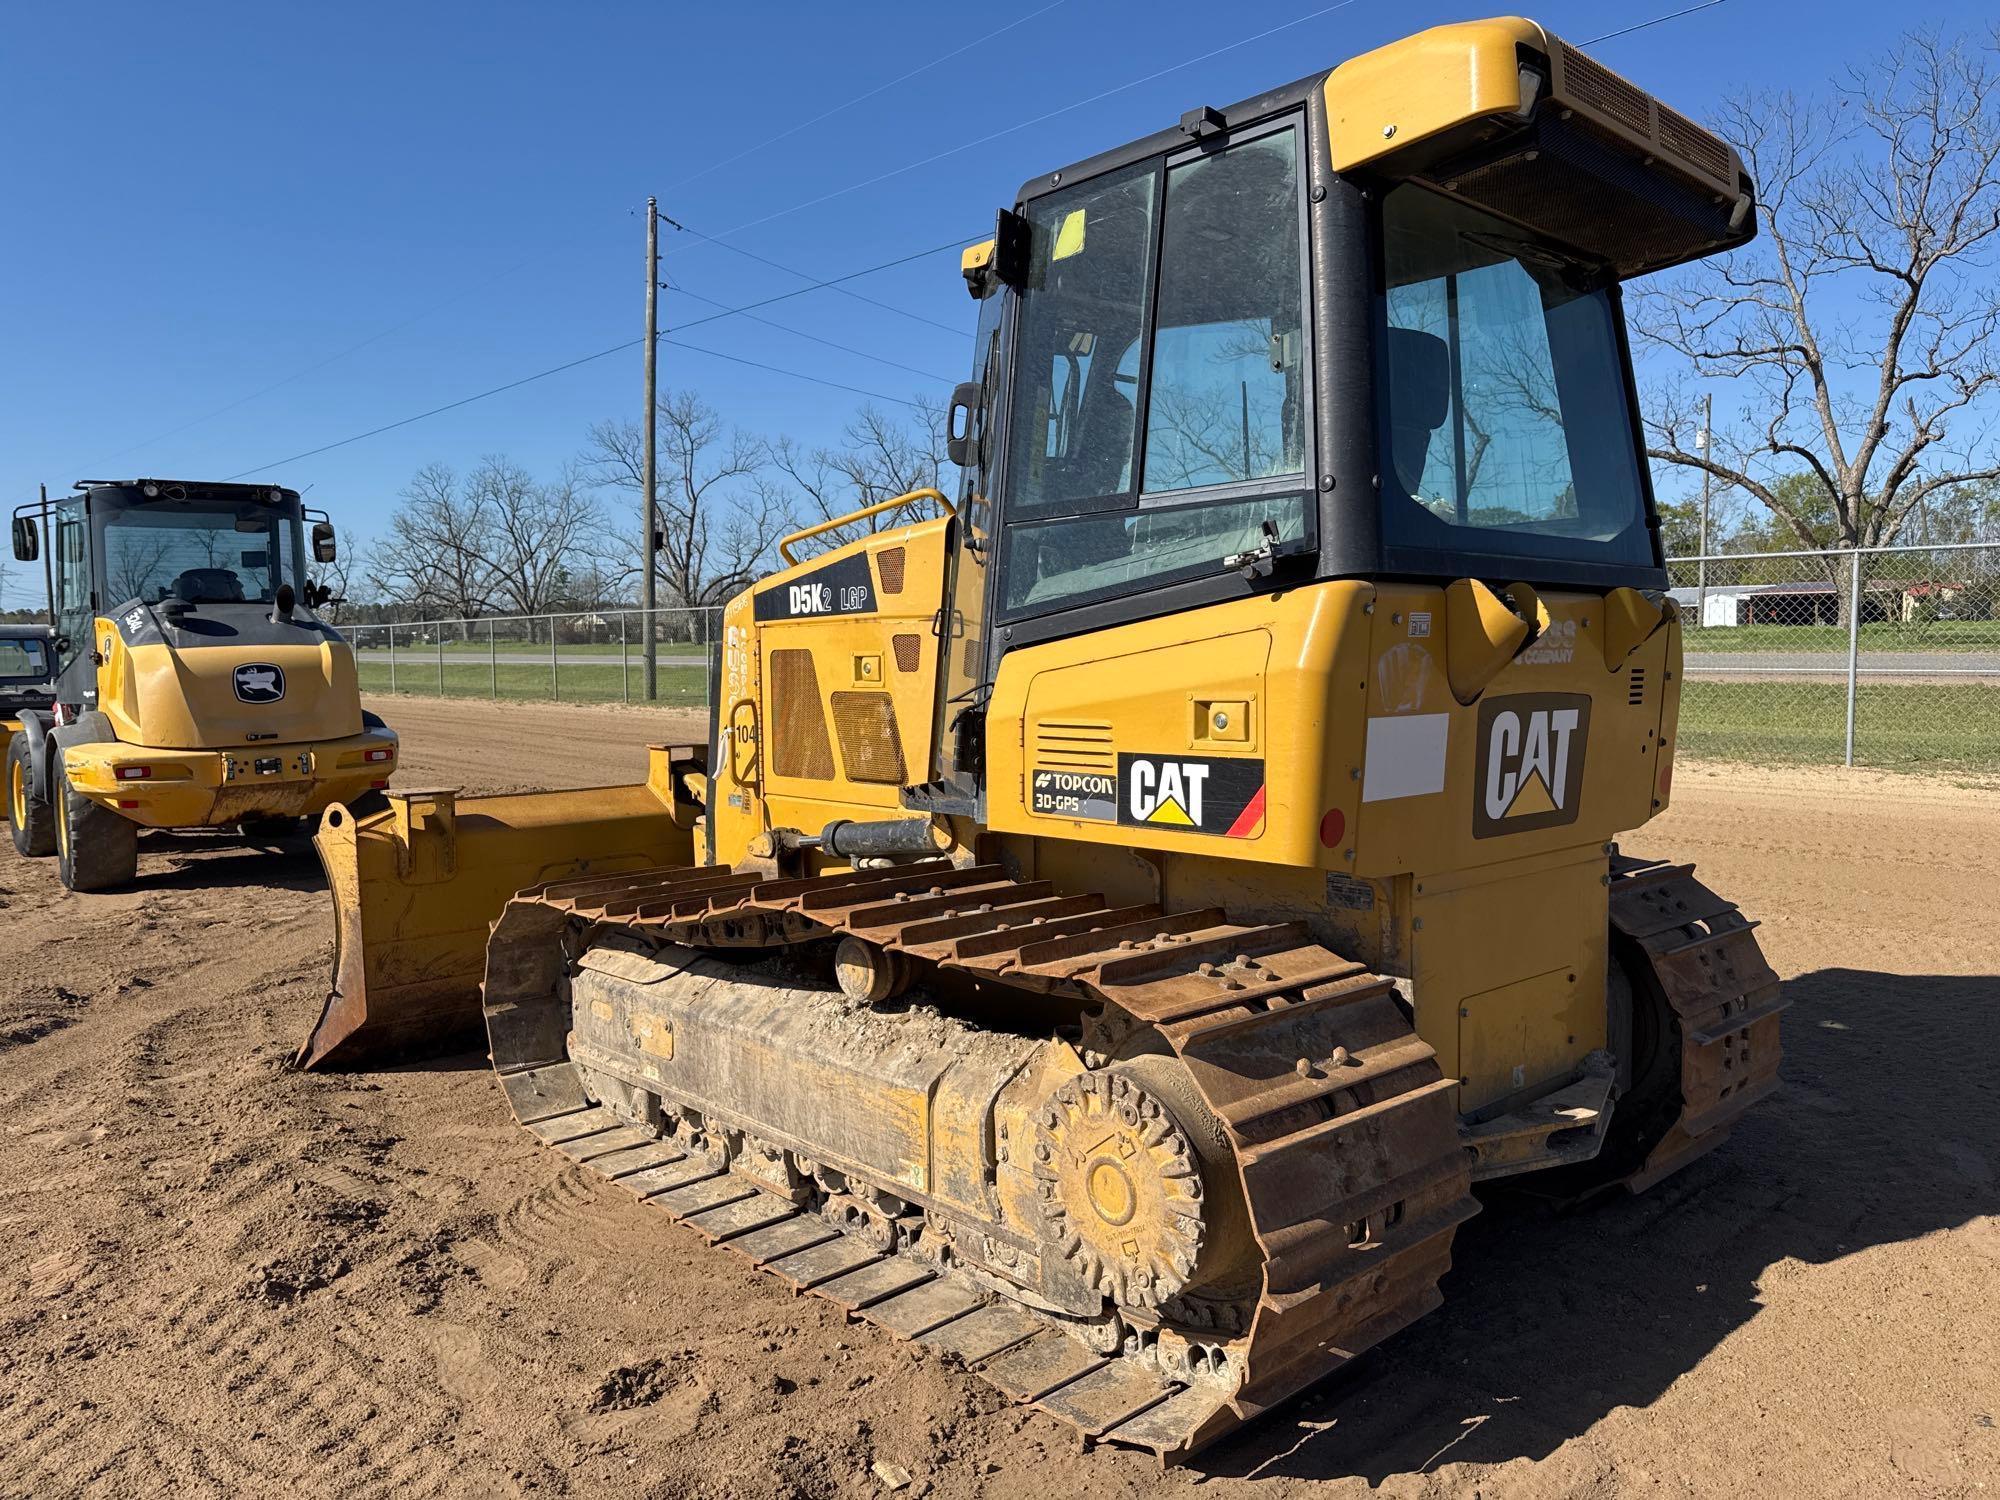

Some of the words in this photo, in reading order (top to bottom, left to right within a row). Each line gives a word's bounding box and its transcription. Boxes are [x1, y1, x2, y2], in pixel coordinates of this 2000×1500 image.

[841, 586, 868, 611] LGP
[1485, 709, 1579, 820] CAT
[1053, 774, 1113, 795] TOPCON
[1130, 759, 1209, 826] CAT
[1035, 793, 1079, 812] 3D-GPS
